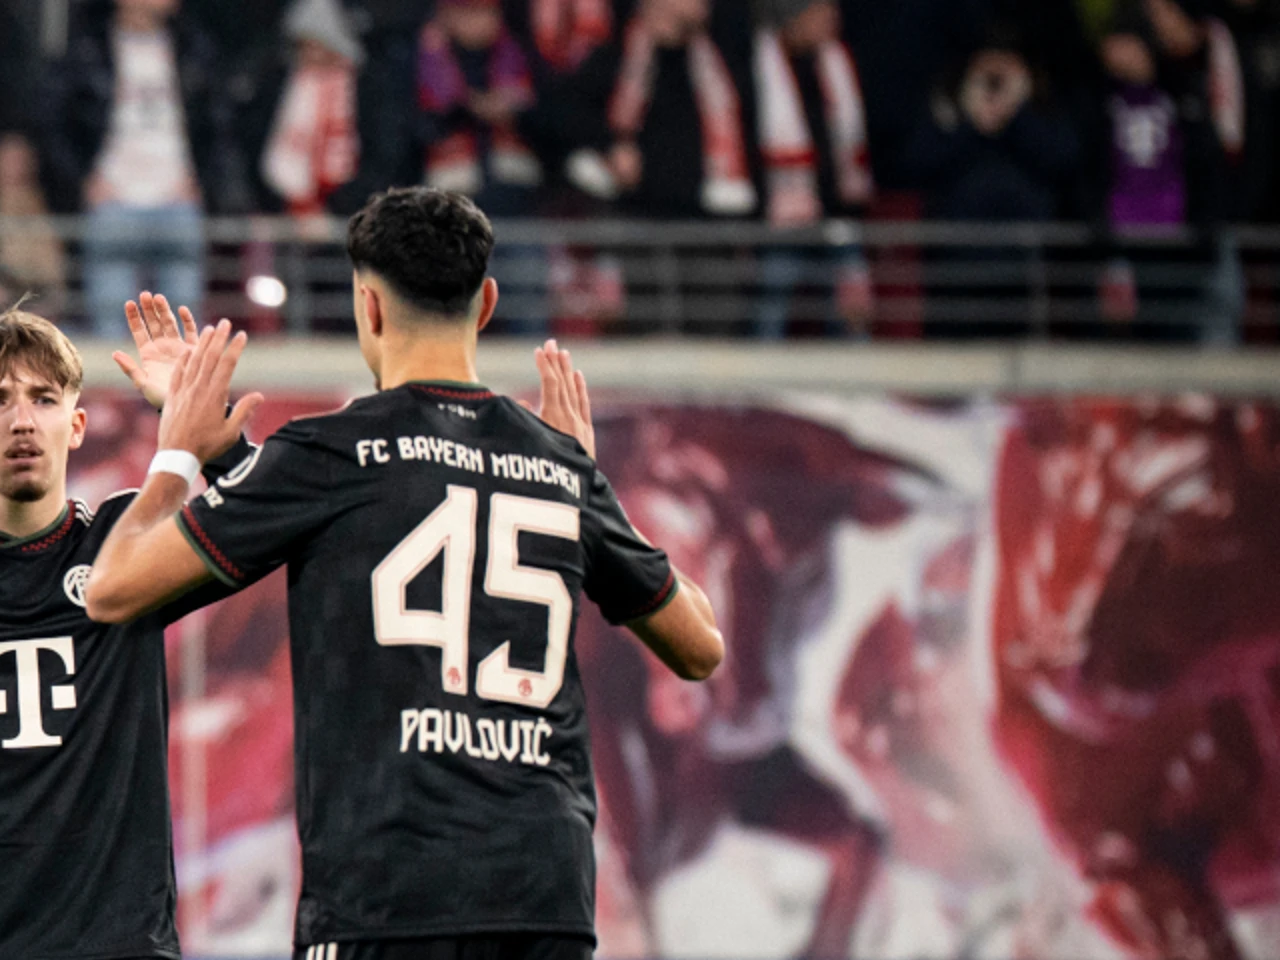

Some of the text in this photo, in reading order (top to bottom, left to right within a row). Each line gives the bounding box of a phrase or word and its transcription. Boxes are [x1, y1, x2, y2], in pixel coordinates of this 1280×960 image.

[356, 436, 581, 498] FC BAYERN MÜNCHEN
[371, 484, 580, 709] 45
[400, 708, 553, 766] PAVLOVIĆ
